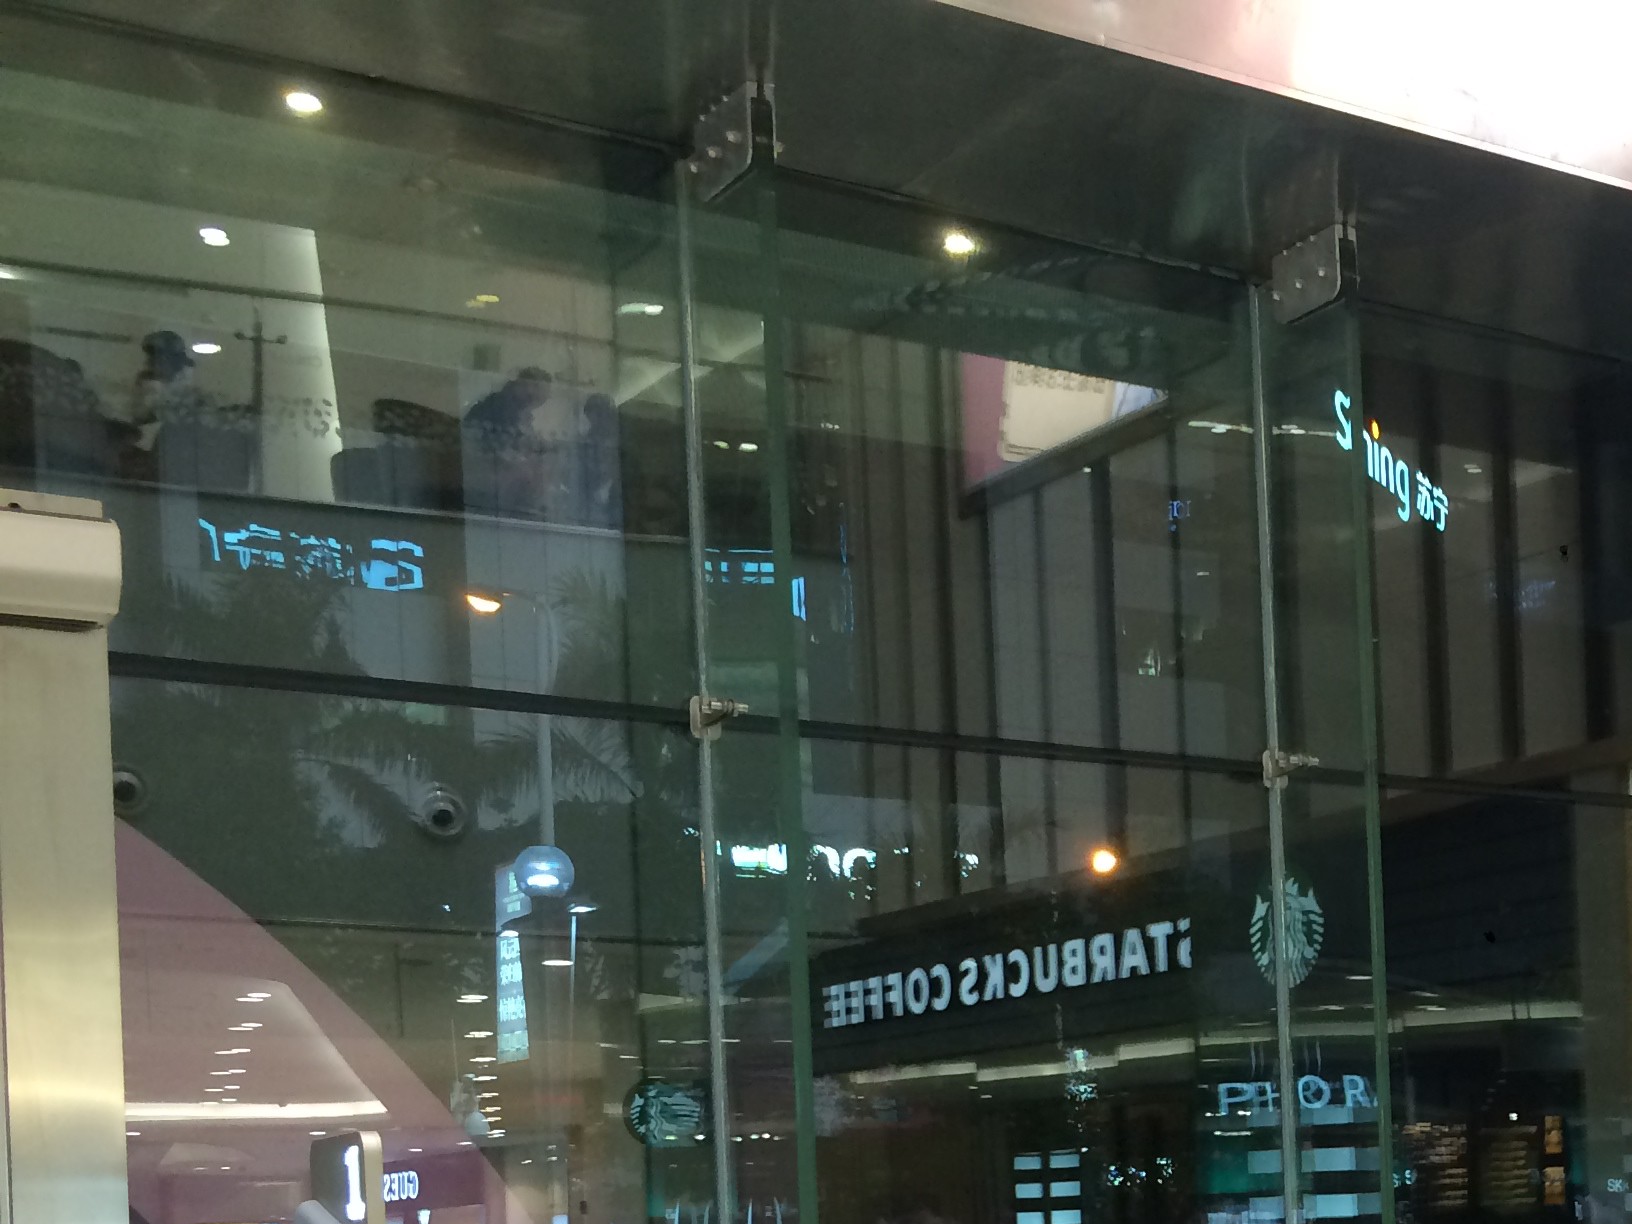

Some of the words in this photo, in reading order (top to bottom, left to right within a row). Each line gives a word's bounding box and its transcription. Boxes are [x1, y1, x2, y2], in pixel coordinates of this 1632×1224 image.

[1335, 389, 1410, 522] Sning
[1416, 470, 1449, 532] 苏宁
[344, 1144, 366, 1222] 1
